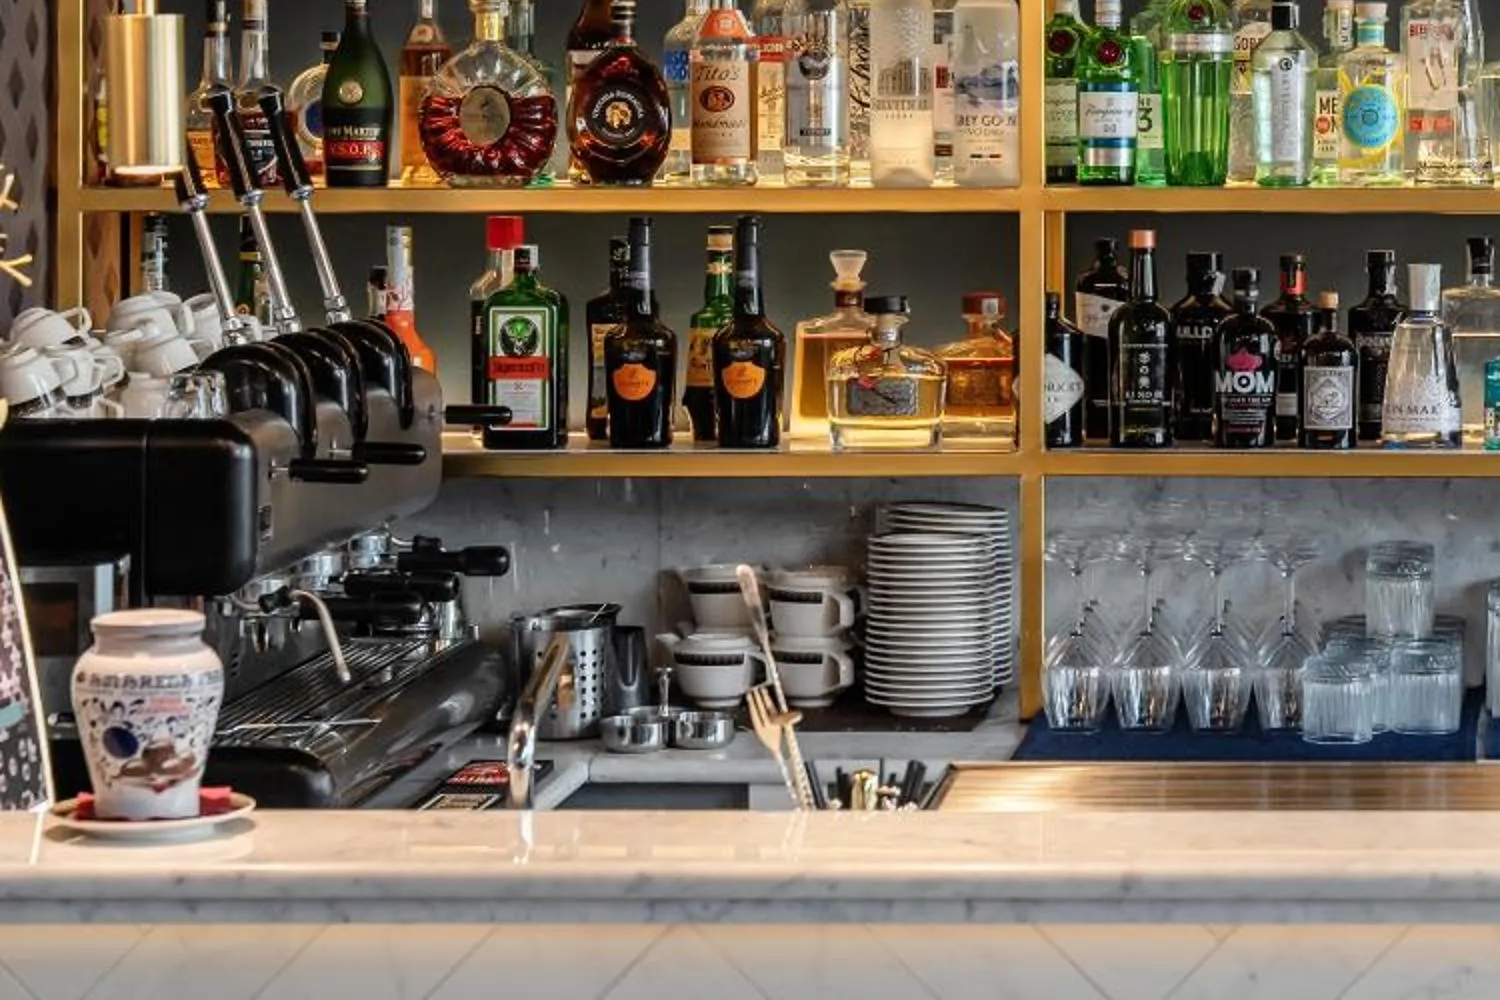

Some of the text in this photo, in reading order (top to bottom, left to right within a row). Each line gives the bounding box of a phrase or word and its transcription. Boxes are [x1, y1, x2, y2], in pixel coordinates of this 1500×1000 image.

[698, 65, 743, 81] Tito's
[1137, 107, 1151, 131] 3
[1177, 326, 1212, 338] ULLD
[1215, 371, 1275, 393] MOM
